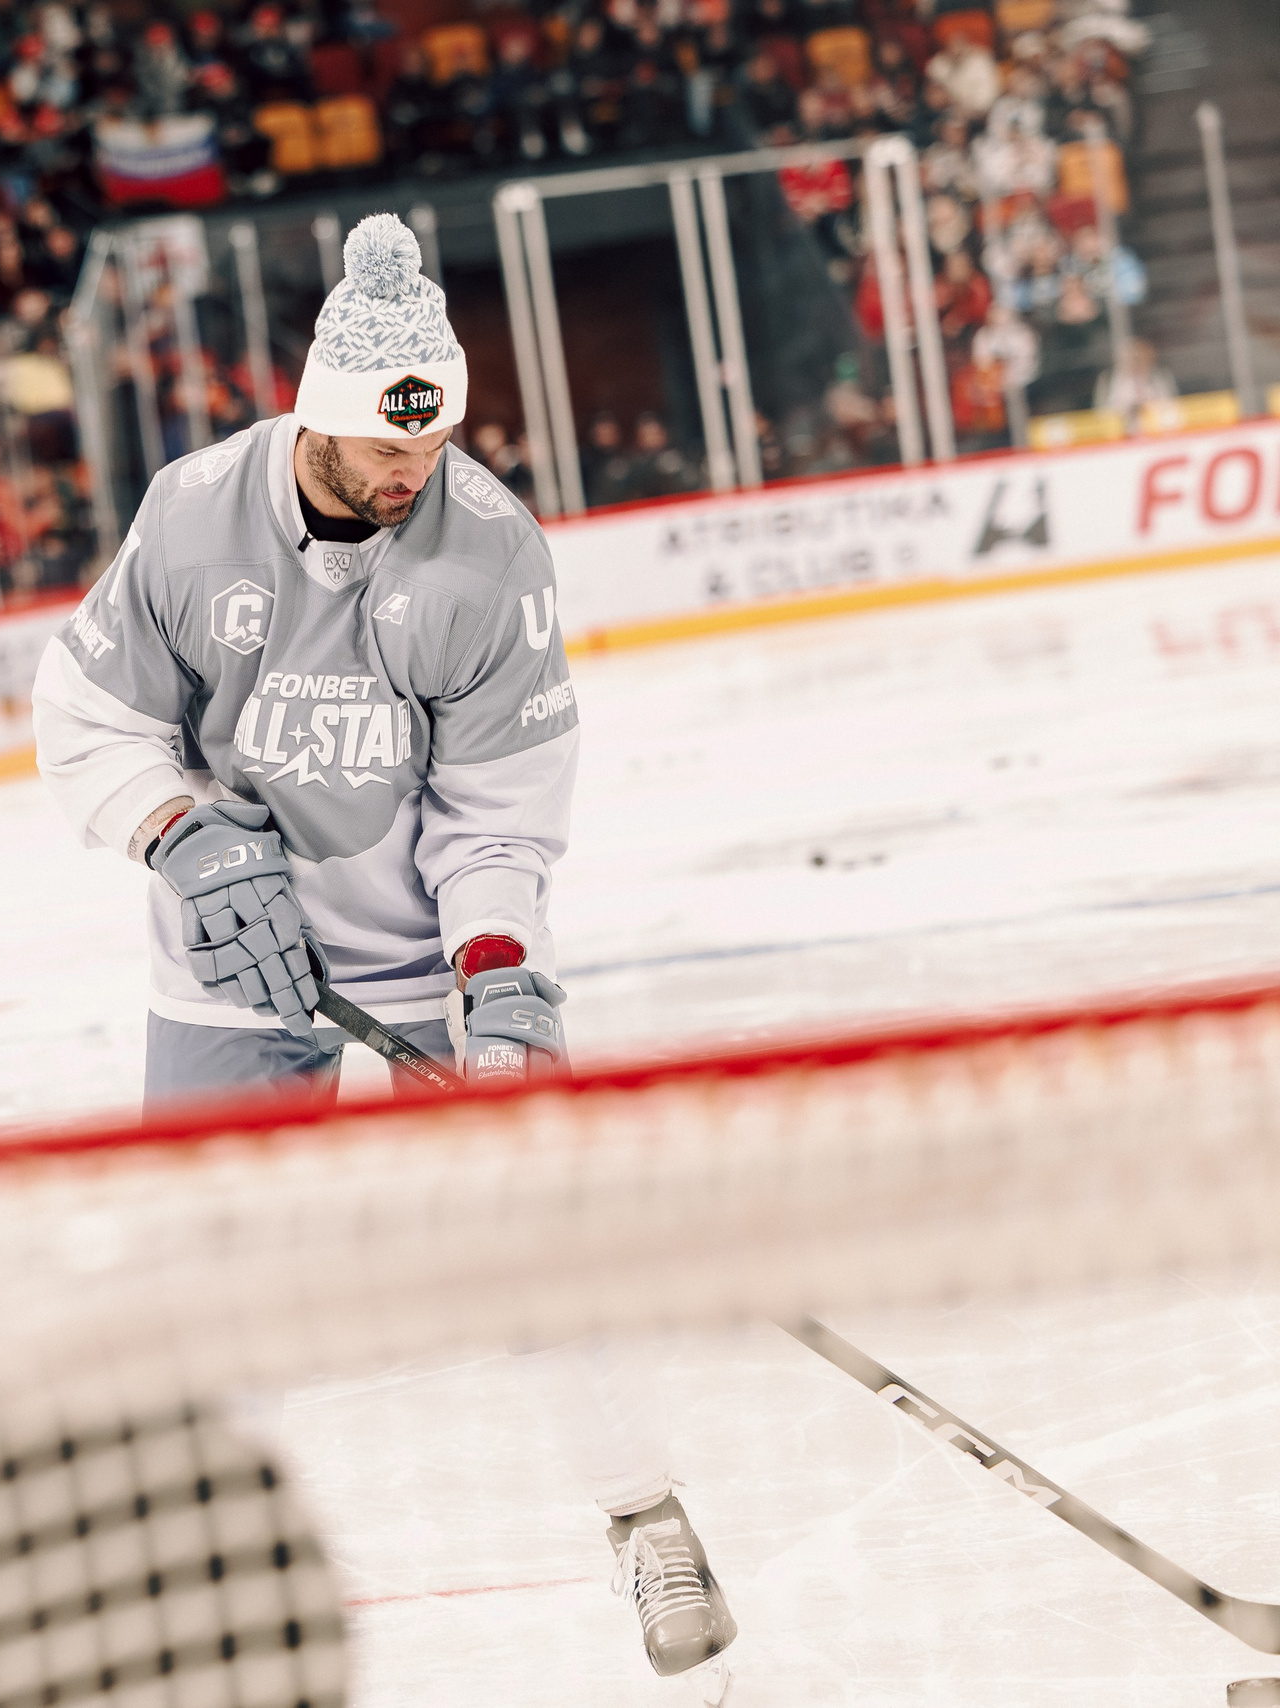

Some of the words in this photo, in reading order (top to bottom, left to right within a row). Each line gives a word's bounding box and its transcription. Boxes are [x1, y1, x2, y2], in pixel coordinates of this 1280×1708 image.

[380, 394, 406, 413] ALL
[409, 388, 442, 410] STAR
[462, 474, 493, 504] RUS
[1136, 447, 1280, 536] FO
[261, 672, 378, 699] FONBET
[521, 678, 575, 728] FONBET
[233, 696, 288, 764] ALL
[310, 700, 412, 768] STAR
[477, 1052, 498, 1069] ALL
[500, 1050, 524, 1069] STAR
[488, 1044, 514, 1052] FONBET
[877, 1383, 1062, 1507] CCM
